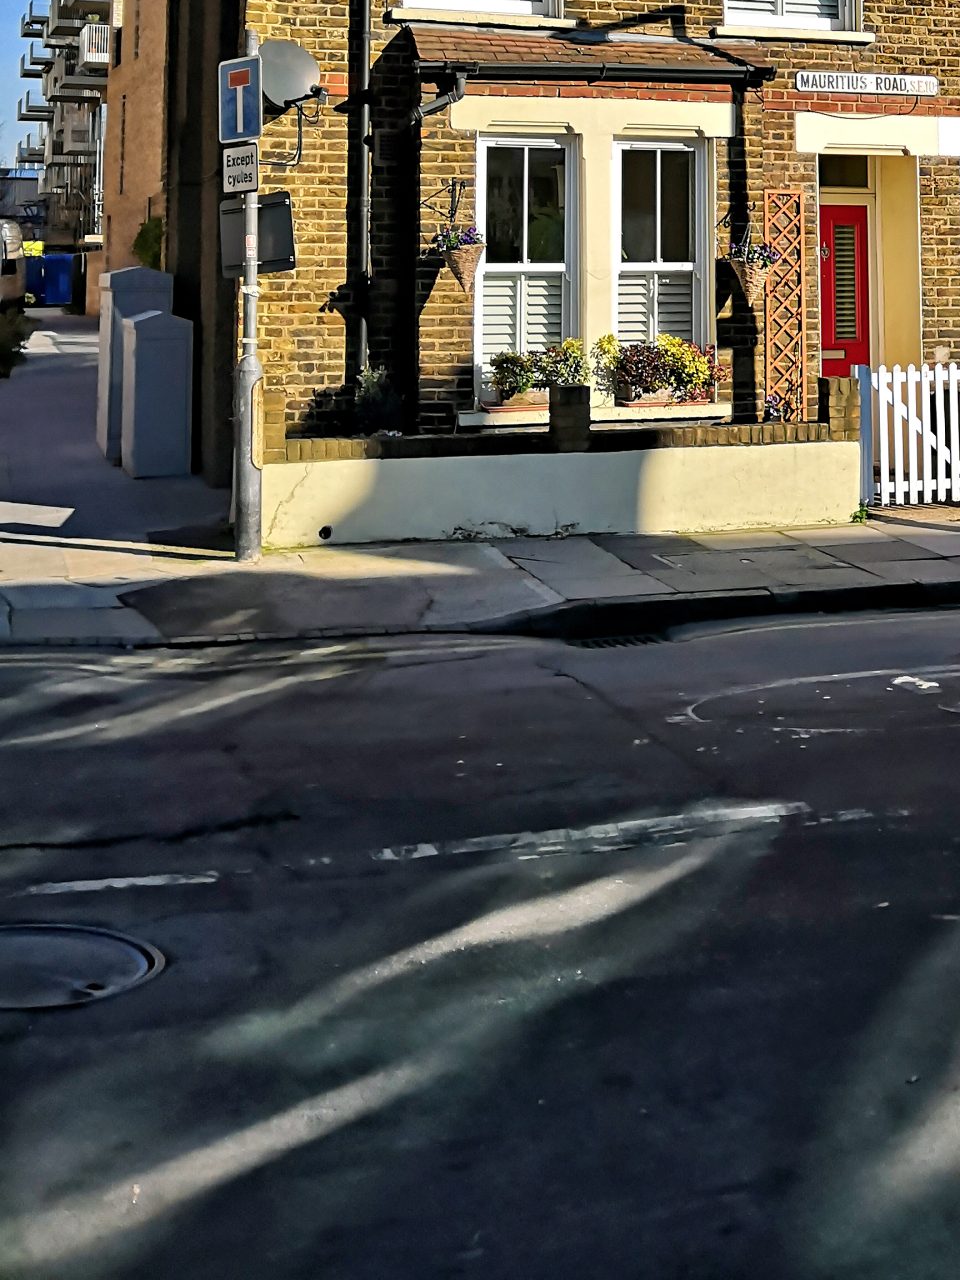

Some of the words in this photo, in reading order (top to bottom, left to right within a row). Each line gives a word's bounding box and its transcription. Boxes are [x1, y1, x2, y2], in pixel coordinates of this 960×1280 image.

[800, 73, 868, 90] MAURITIUS
[226, 152, 254, 168] Except
[227, 170, 253, 187] cycles
